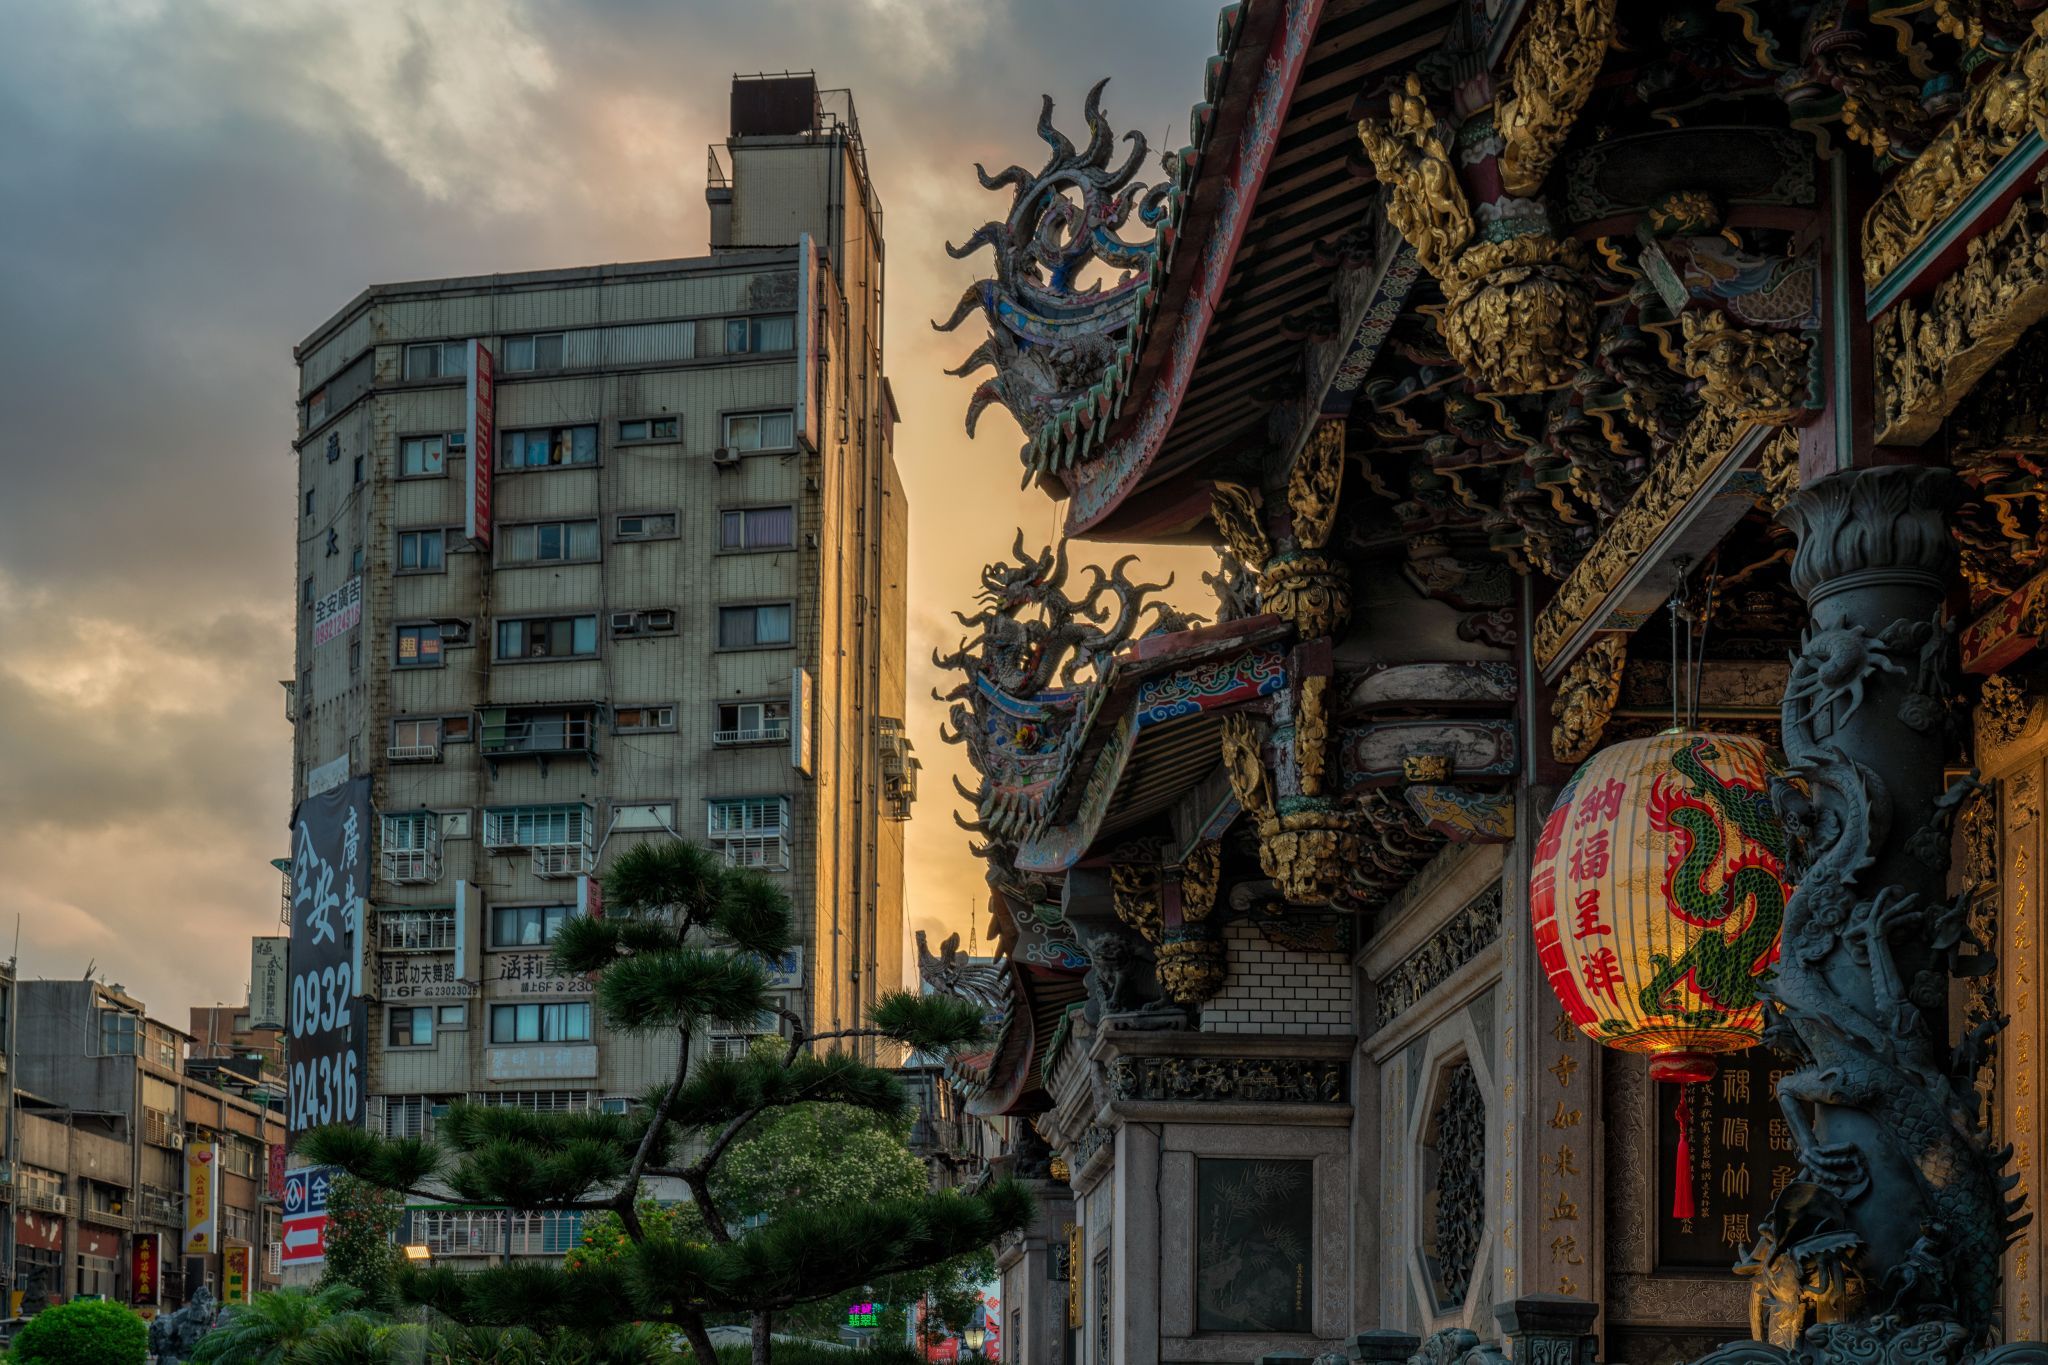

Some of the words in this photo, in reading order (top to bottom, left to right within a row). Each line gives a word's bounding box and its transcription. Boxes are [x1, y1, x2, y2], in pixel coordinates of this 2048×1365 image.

[477, 416, 489, 508] HOTEL
[316, 576, 360, 623] 全安廣告
[1569, 777, 1626, 1008] 納福呈祥
[293, 961, 351, 1039] 0932
[500, 954, 579, 981] 涵莉美
[289, 1049, 357, 1132] 124316
